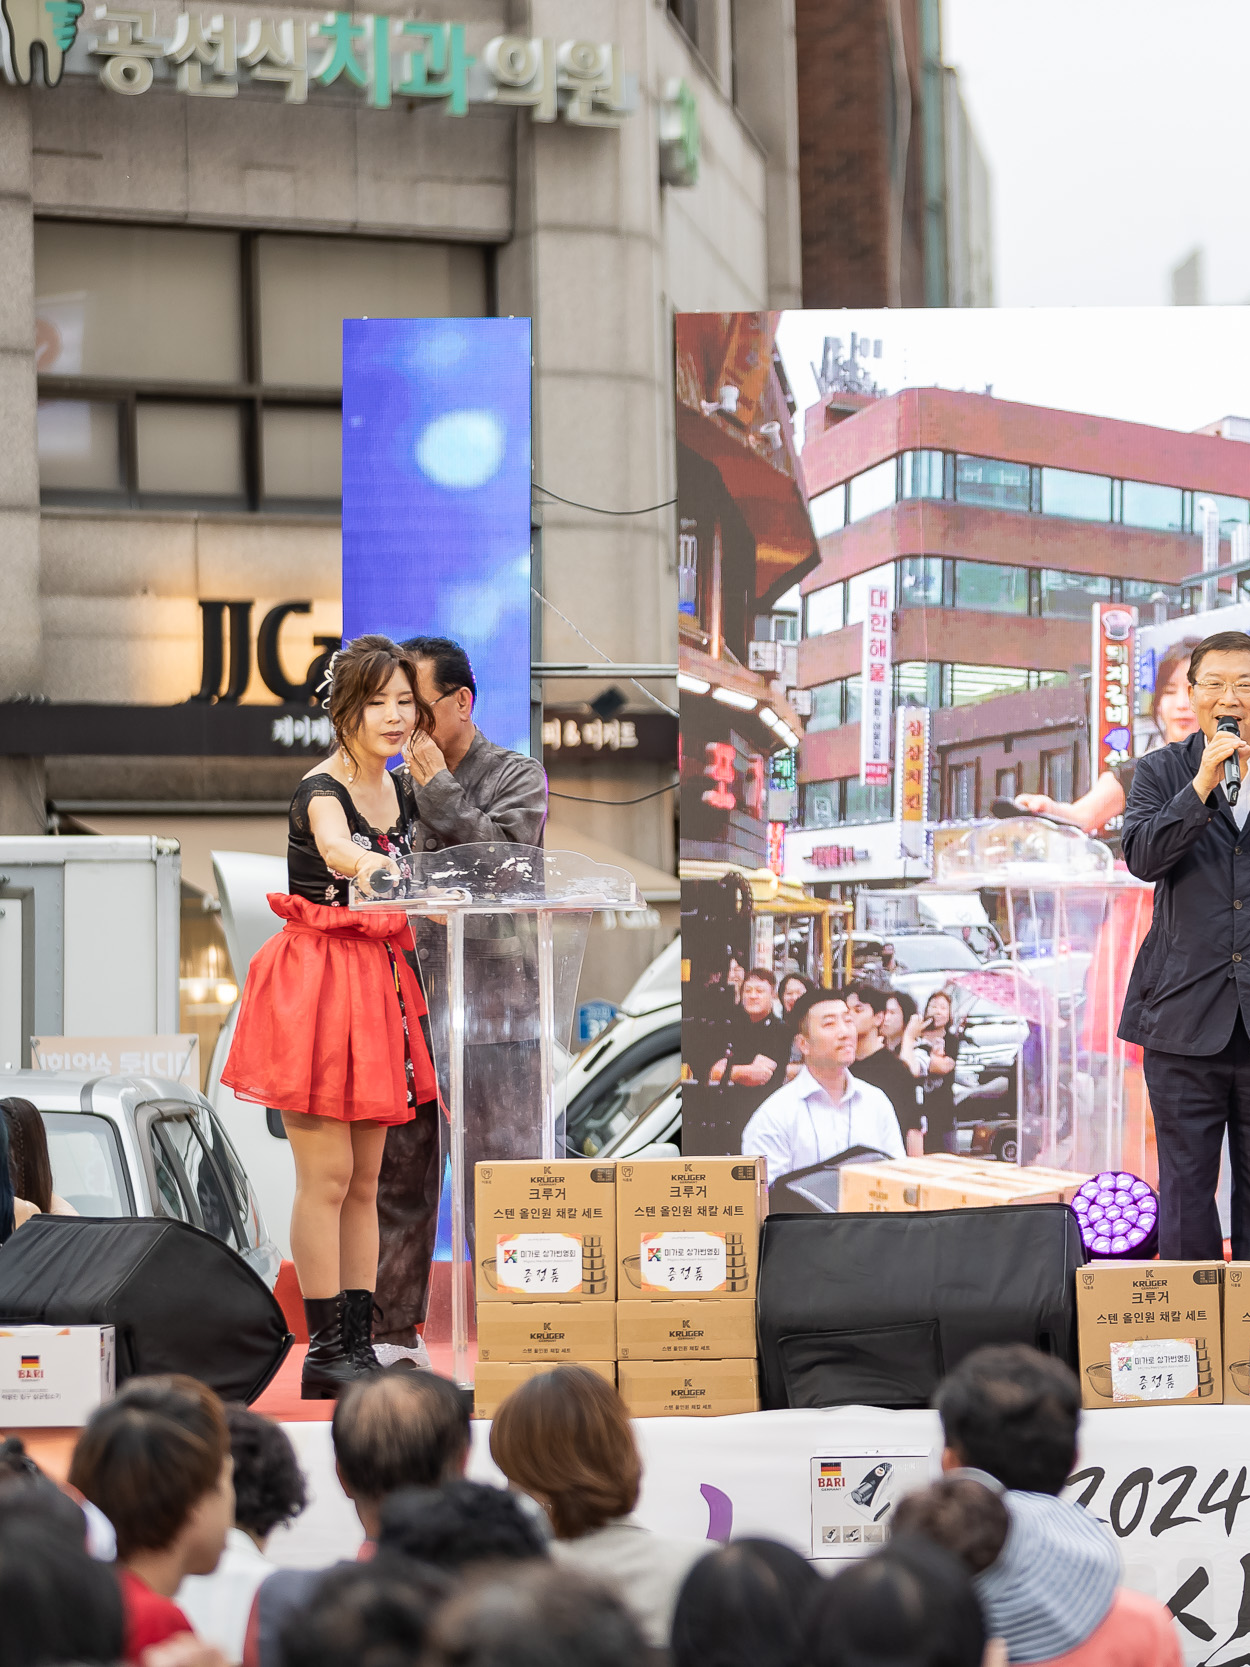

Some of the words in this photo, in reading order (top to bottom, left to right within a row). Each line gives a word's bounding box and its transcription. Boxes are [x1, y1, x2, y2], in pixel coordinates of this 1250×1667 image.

[530, 1175, 565, 1184] KRÜGER
[671, 1174, 706, 1182] KRÜGER
[529, 1188, 567, 1201] 크루거
[670, 1186, 707, 1199] 크루거
[493, 1208, 515, 1220] 스텐
[519, 1207, 552, 1220] 올인원
[556, 1207, 578, 1220] 채칼
[582, 1208, 603, 1219] 세트
[634, 1206, 656, 1218] 스텐
[660, 1205, 693, 1217] 올인원
[697, 1205, 719, 1218] 채칼
[723, 1206, 744, 1217] 세트
[520, 1249, 540, 1258] 미가로
[542, 1249, 576, 1258] 상가번영회
[664, 1248, 684, 1257] 미가로
[686, 1248, 720, 1257] 상가번영회
[1132, 1279, 1168, 1288] KRÜGER
[1131, 1291, 1170, 1305] 크루거
[1096, 1313, 1118, 1324] 스텐
[1122, 1311, 1155, 1324] 올인원
[1159, 1310, 1182, 1323] 채칼
[1185, 1310, 1207, 1322] 세트
[529, 1331, 566, 1340] KRÜGER
[669, 1329, 704, 1338] KRÜGER
[1134, 1355, 1155, 1365] 미가로
[1156, 1354, 1191, 1364] 상가번영회
[17, 1369, 44, 1379] BARI
[670, 1388, 706, 1397] KRÜGER
[817, 1477, 846, 1488] BARI
